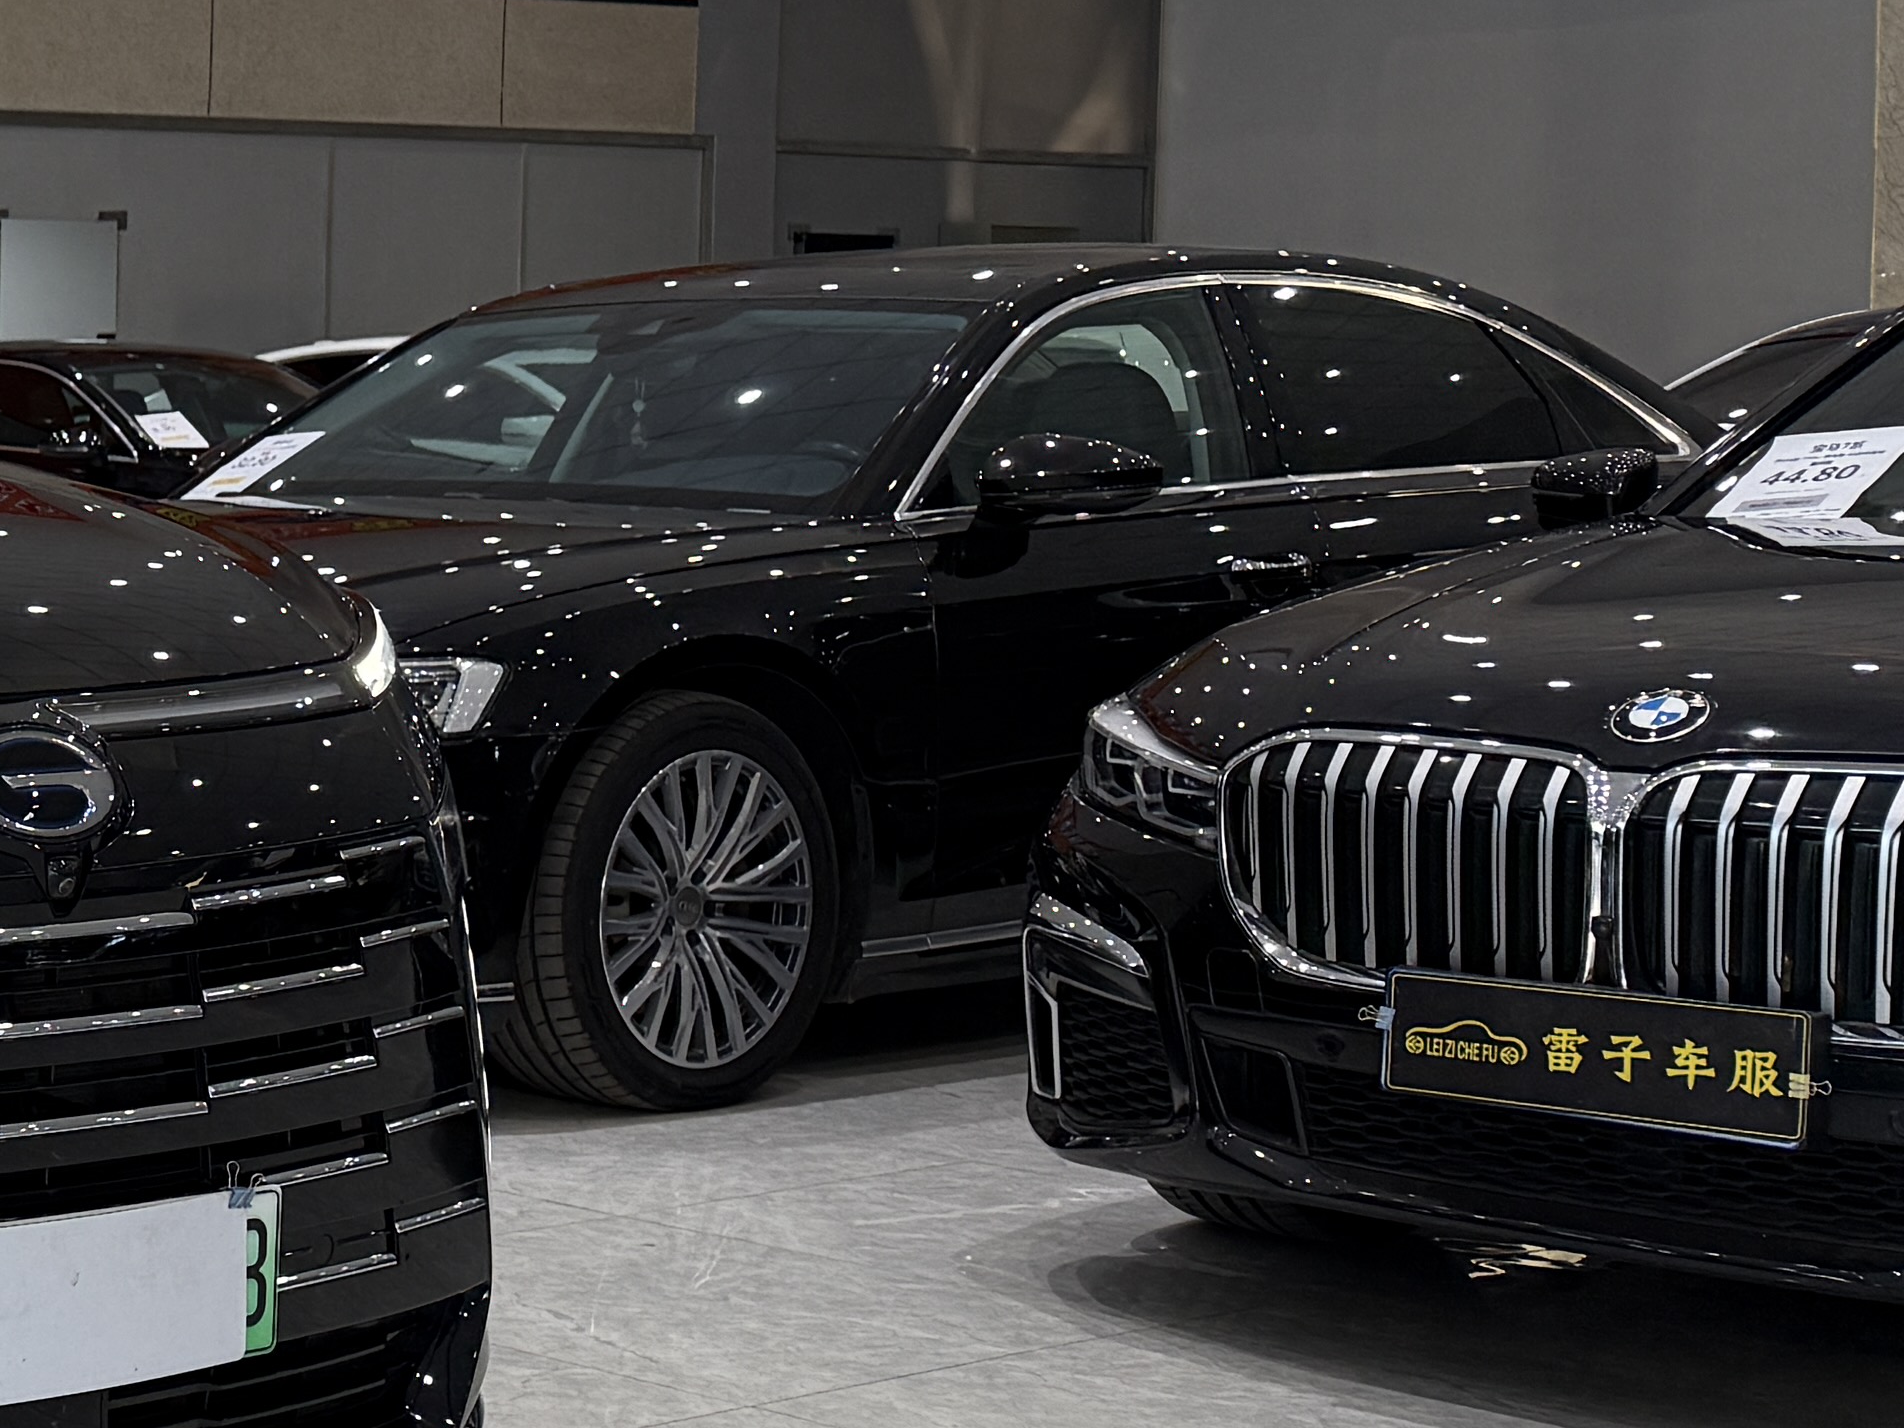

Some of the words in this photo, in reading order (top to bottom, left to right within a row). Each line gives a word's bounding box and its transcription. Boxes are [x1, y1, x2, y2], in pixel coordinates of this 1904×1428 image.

[1760, 463, 1862, 486] 44.80
[1426, 1039, 1442, 1060] LEI
[1444, 1041, 1455, 1060] ZI
[1457, 1041, 1480, 1063] CHE
[1481, 1042, 1498, 1064] FU
[1541, 1027, 1784, 1098] 雷子车服
